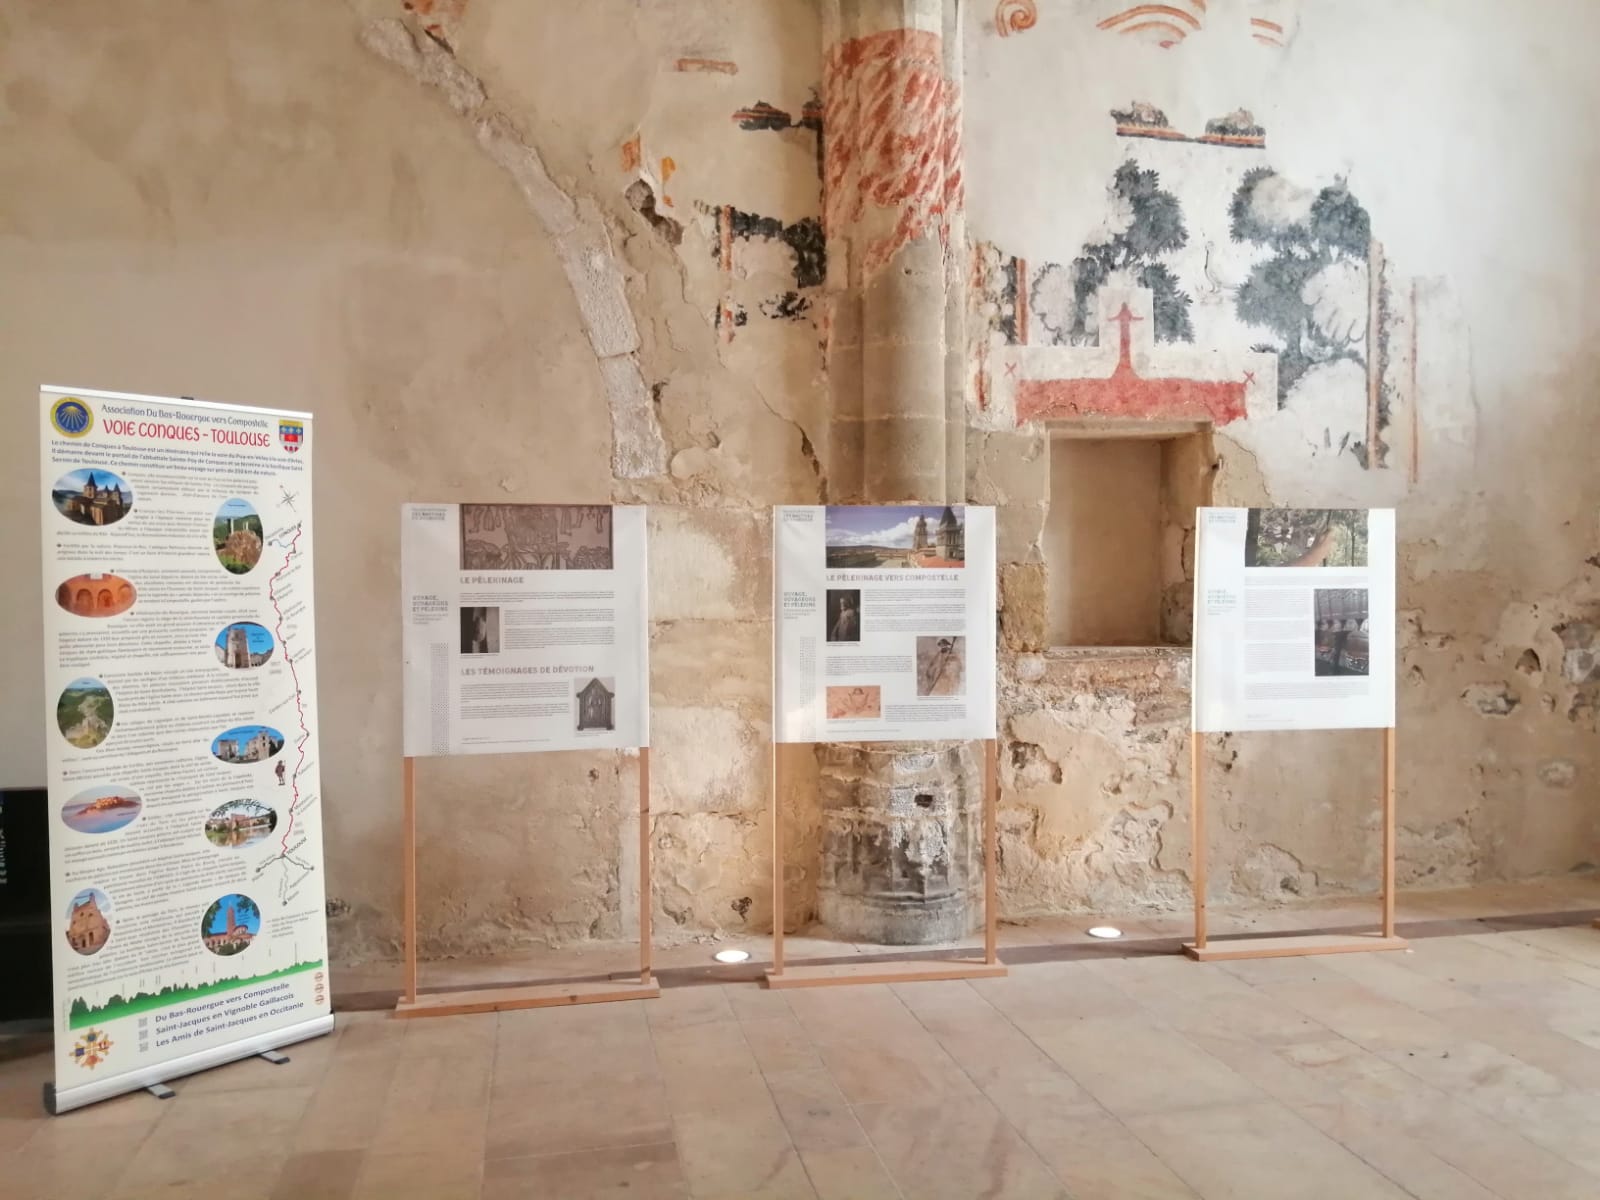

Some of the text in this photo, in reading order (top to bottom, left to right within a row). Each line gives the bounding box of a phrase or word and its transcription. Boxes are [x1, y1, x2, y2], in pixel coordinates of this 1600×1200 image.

[101, 404, 268, 428] Association Du Bas-Rouergue vers Compostelle
[103, 418, 136, 436] VOIE
[138, 422, 200, 442] CONQUES
[210, 428, 270, 447] TOULOUSE
[91, 442, 116, 450] Conques
[122, 444, 147, 452] Toulouse
[459, 576, 470, 585] LE
[826, 574, 835, 582] LE
[885, 574, 903, 582] VERS
[905, 574, 959, 582] COMPOSTELLE
[461, 664, 594, 676] LES TÉMOIGNAGES DE DÉVOTION
[155, 982, 290, 1023] Du Bas-Rouergue vers Compostelle
[156, 993, 294, 1035] Saint-Jacques en Vignoble Gaillacois
[156, 1001, 304, 1047] Les Amis de Saint-Jacques en Occitanie
